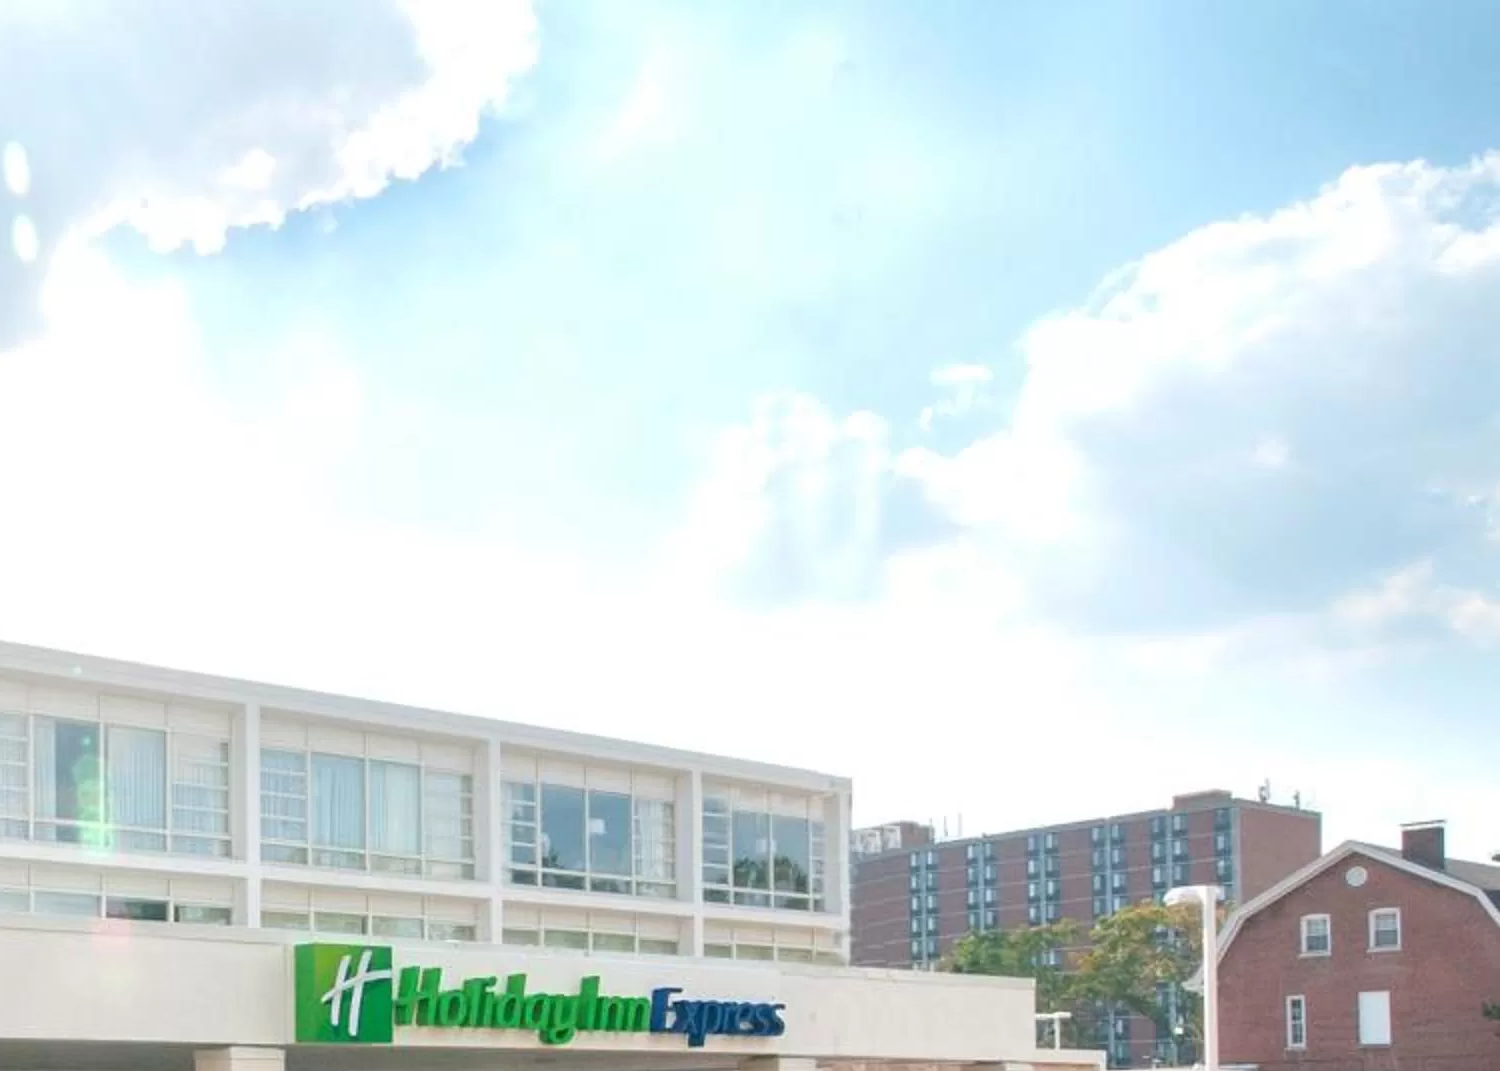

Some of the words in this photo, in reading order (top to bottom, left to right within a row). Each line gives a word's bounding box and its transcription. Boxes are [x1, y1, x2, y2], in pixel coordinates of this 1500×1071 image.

[394, 966, 578, 1045] Holiday
[577, 976, 650, 1032] Inn
[651, 987, 786, 1048] Express
